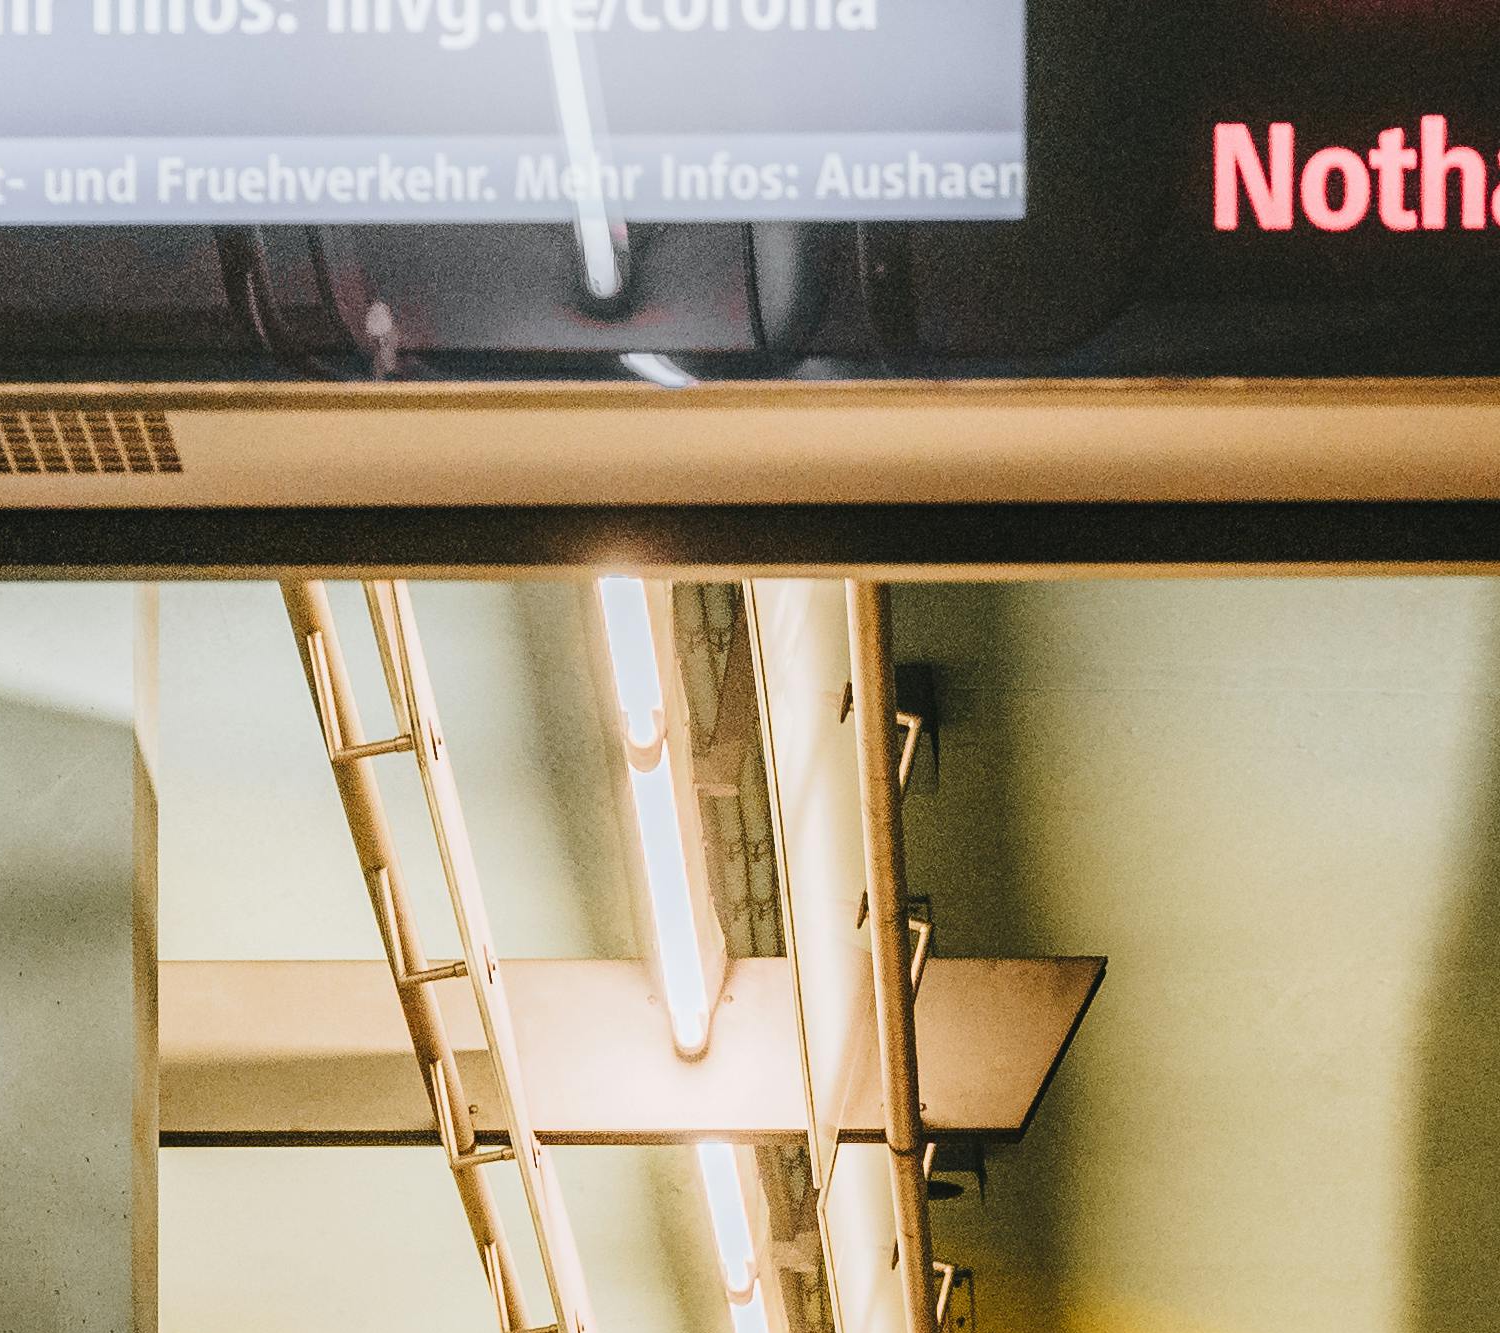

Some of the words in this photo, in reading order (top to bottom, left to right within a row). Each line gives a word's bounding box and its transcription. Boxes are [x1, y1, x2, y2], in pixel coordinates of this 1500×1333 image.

[44, 154, 137, 204] und
[158, 152, 497, 204] Fruehverkehr.
[515, 153, 643, 201] Mehr
[662, 152, 800, 201] Infos:
[816, 152, 1026, 201] Aushaen
